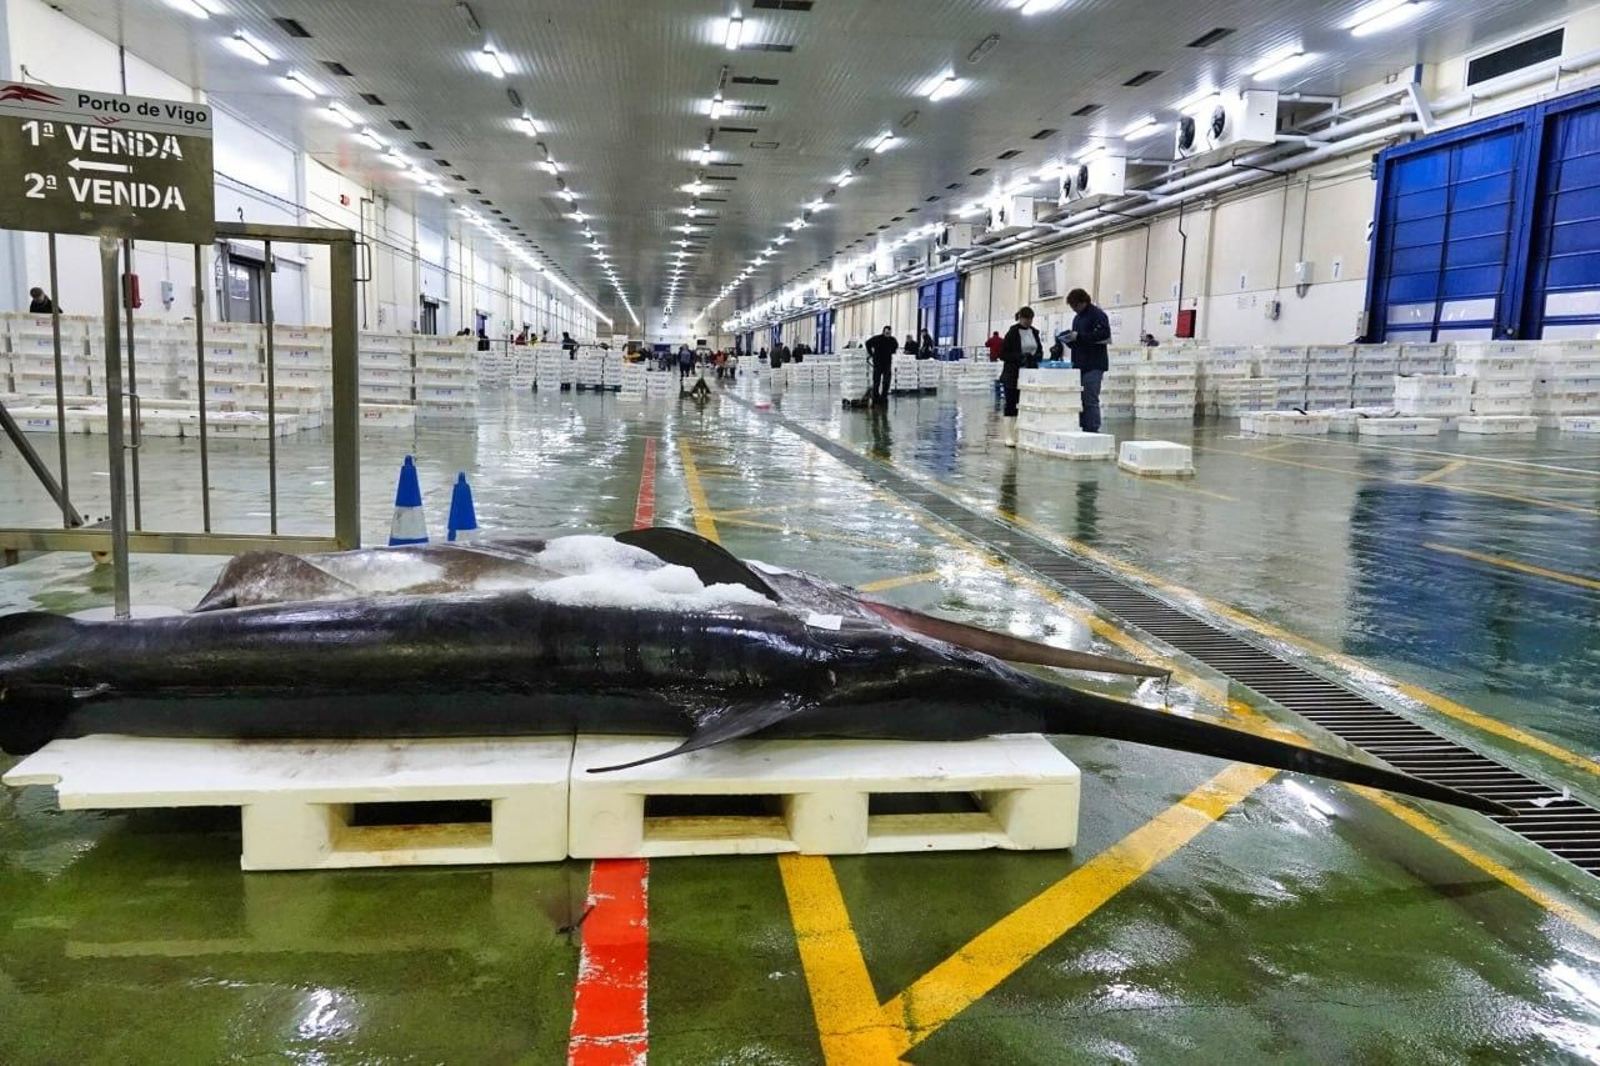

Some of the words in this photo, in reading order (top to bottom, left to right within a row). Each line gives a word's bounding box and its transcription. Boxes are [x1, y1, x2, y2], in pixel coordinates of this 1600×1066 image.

[78, 95, 130, 113] Porto
[137, 102, 160, 116] de
[165, 105, 207, 124] Vigo
[21, 121, 54, 146] 1ª
[65, 125, 183, 161] VENDA
[24, 173, 57, 199] 2ª
[67, 177, 186, 212] VENDA
